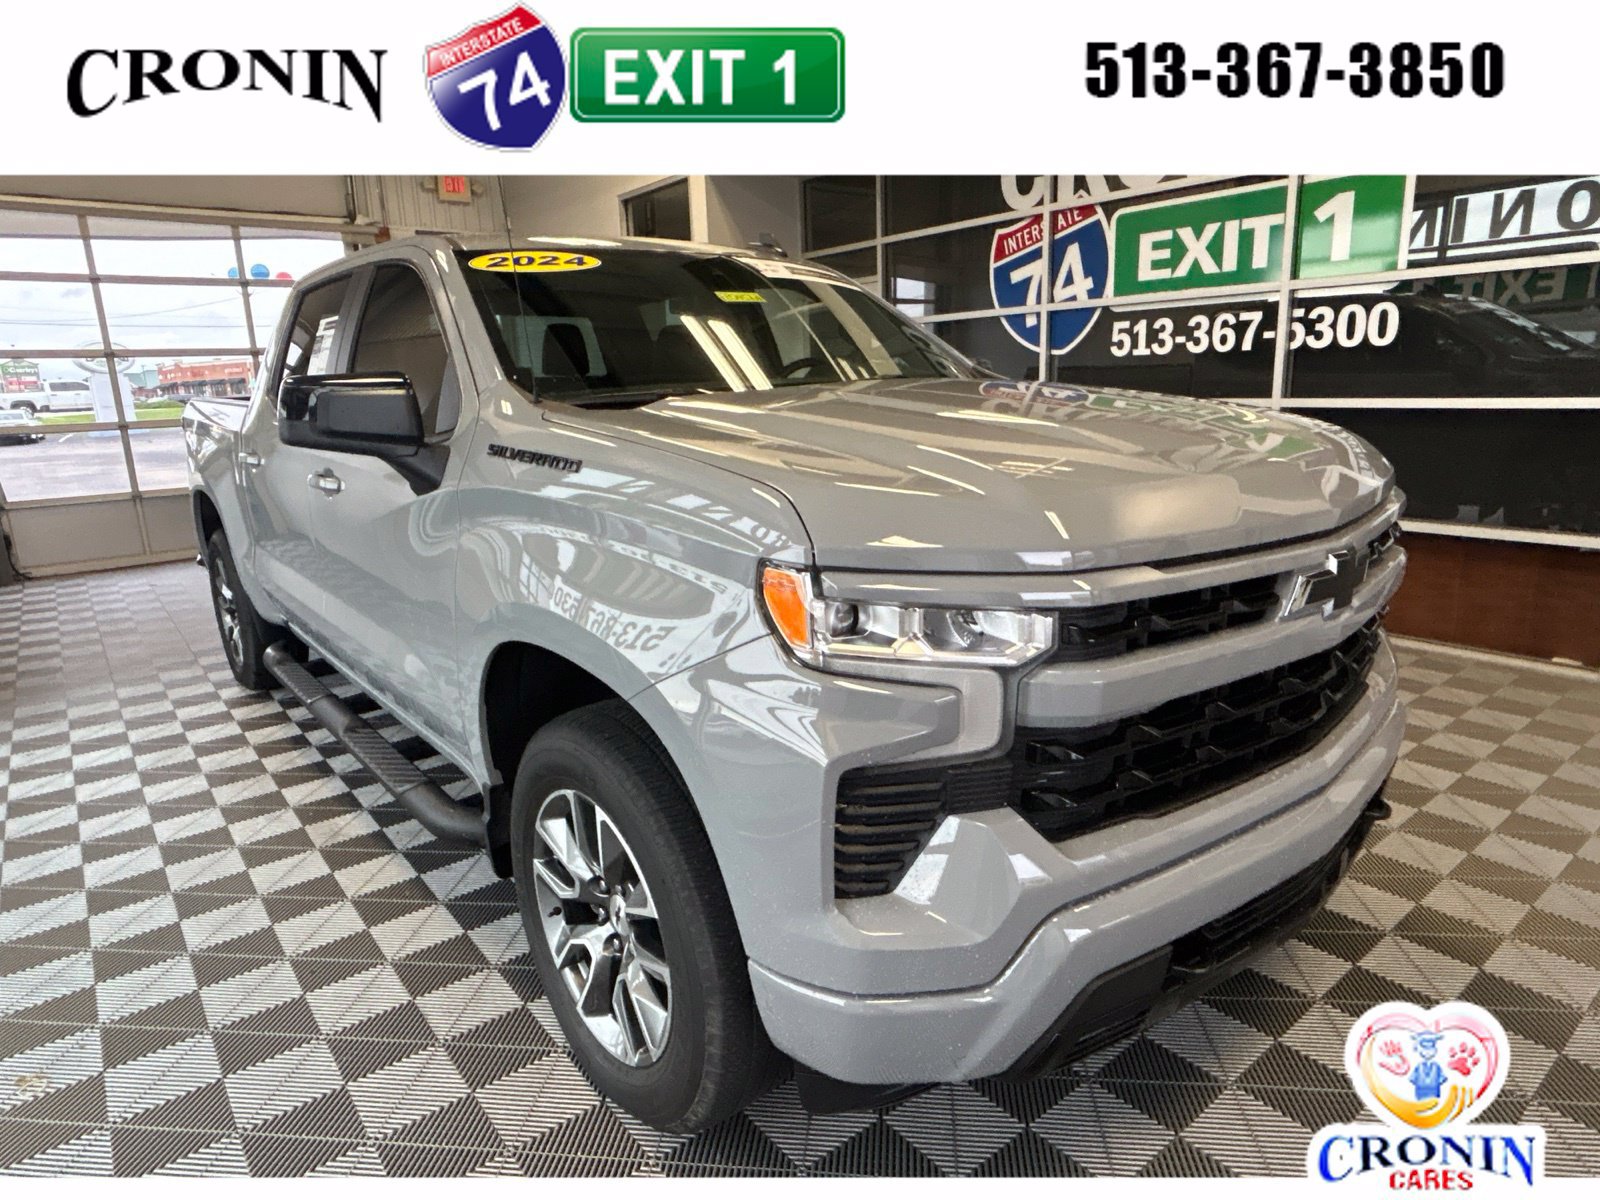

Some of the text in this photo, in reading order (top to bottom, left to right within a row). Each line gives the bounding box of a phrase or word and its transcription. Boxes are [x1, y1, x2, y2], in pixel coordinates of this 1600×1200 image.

[486, 256, 586, 268] 2024
[1137, 190, 1356, 282] EXIT 1
[1009, 242, 1094, 328] 74
[1109, 301, 1400, 358] 513-367-5300
